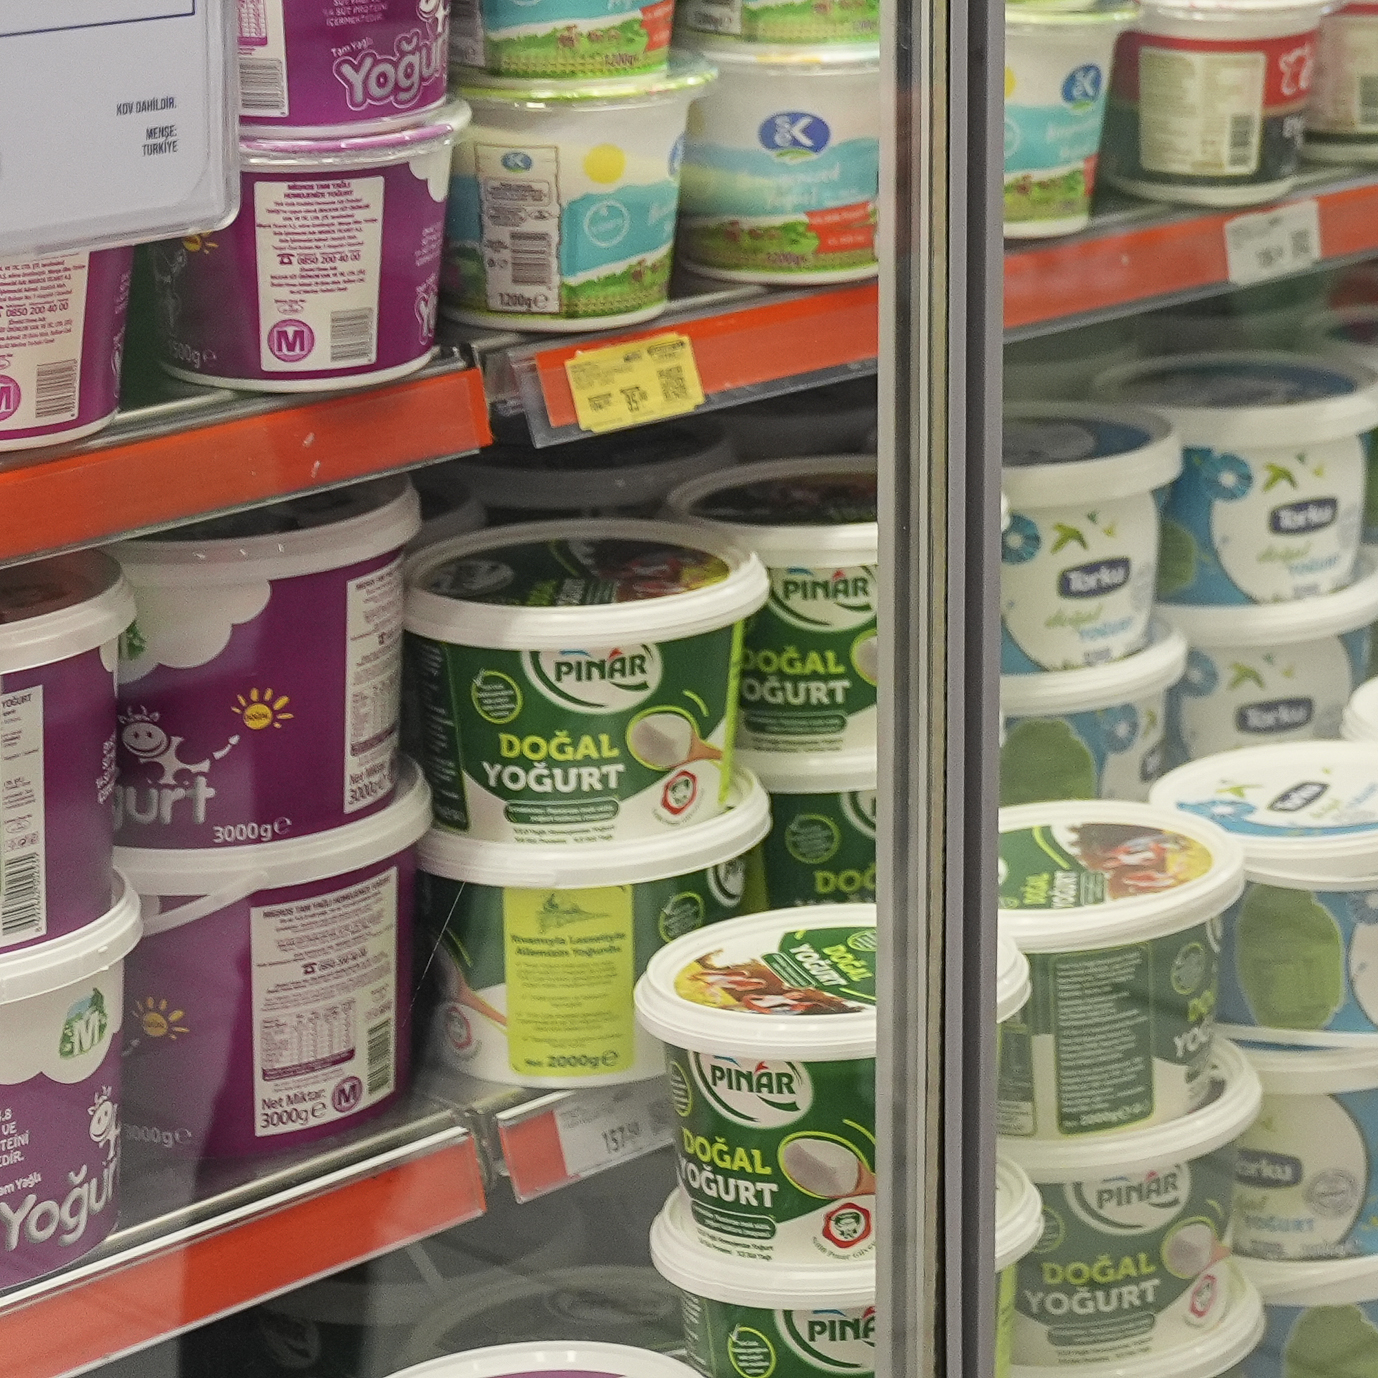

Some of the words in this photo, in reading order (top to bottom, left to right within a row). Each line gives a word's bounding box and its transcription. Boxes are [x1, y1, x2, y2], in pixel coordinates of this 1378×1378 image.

[135, 95, 177, 114] DAHİLDİR.
[29, 306, 46, 316] 200
[47, 304, 58, 313] 40
[58, 301, 69, 312] 00
[554, 652, 648, 684] PINAR
[741, 676, 852, 707] OĞURT
[499, 730, 620, 762] DOĞAL
[482, 762, 626, 794] YOĞURT
[212, 820, 275, 845] 3000g
[547, 1054, 600, 1069] 2000g
[709, 1060, 797, 1096] PINAR
[260, 1108, 310, 1129] 3000g
[681, 1123, 773, 1175] DOĞAL
[15, 1172, 42, 1192] Yağlı
[1041, 1251, 1158, 1287] DOĞAL
[1023, 1277, 1163, 1317] YOĞURT
